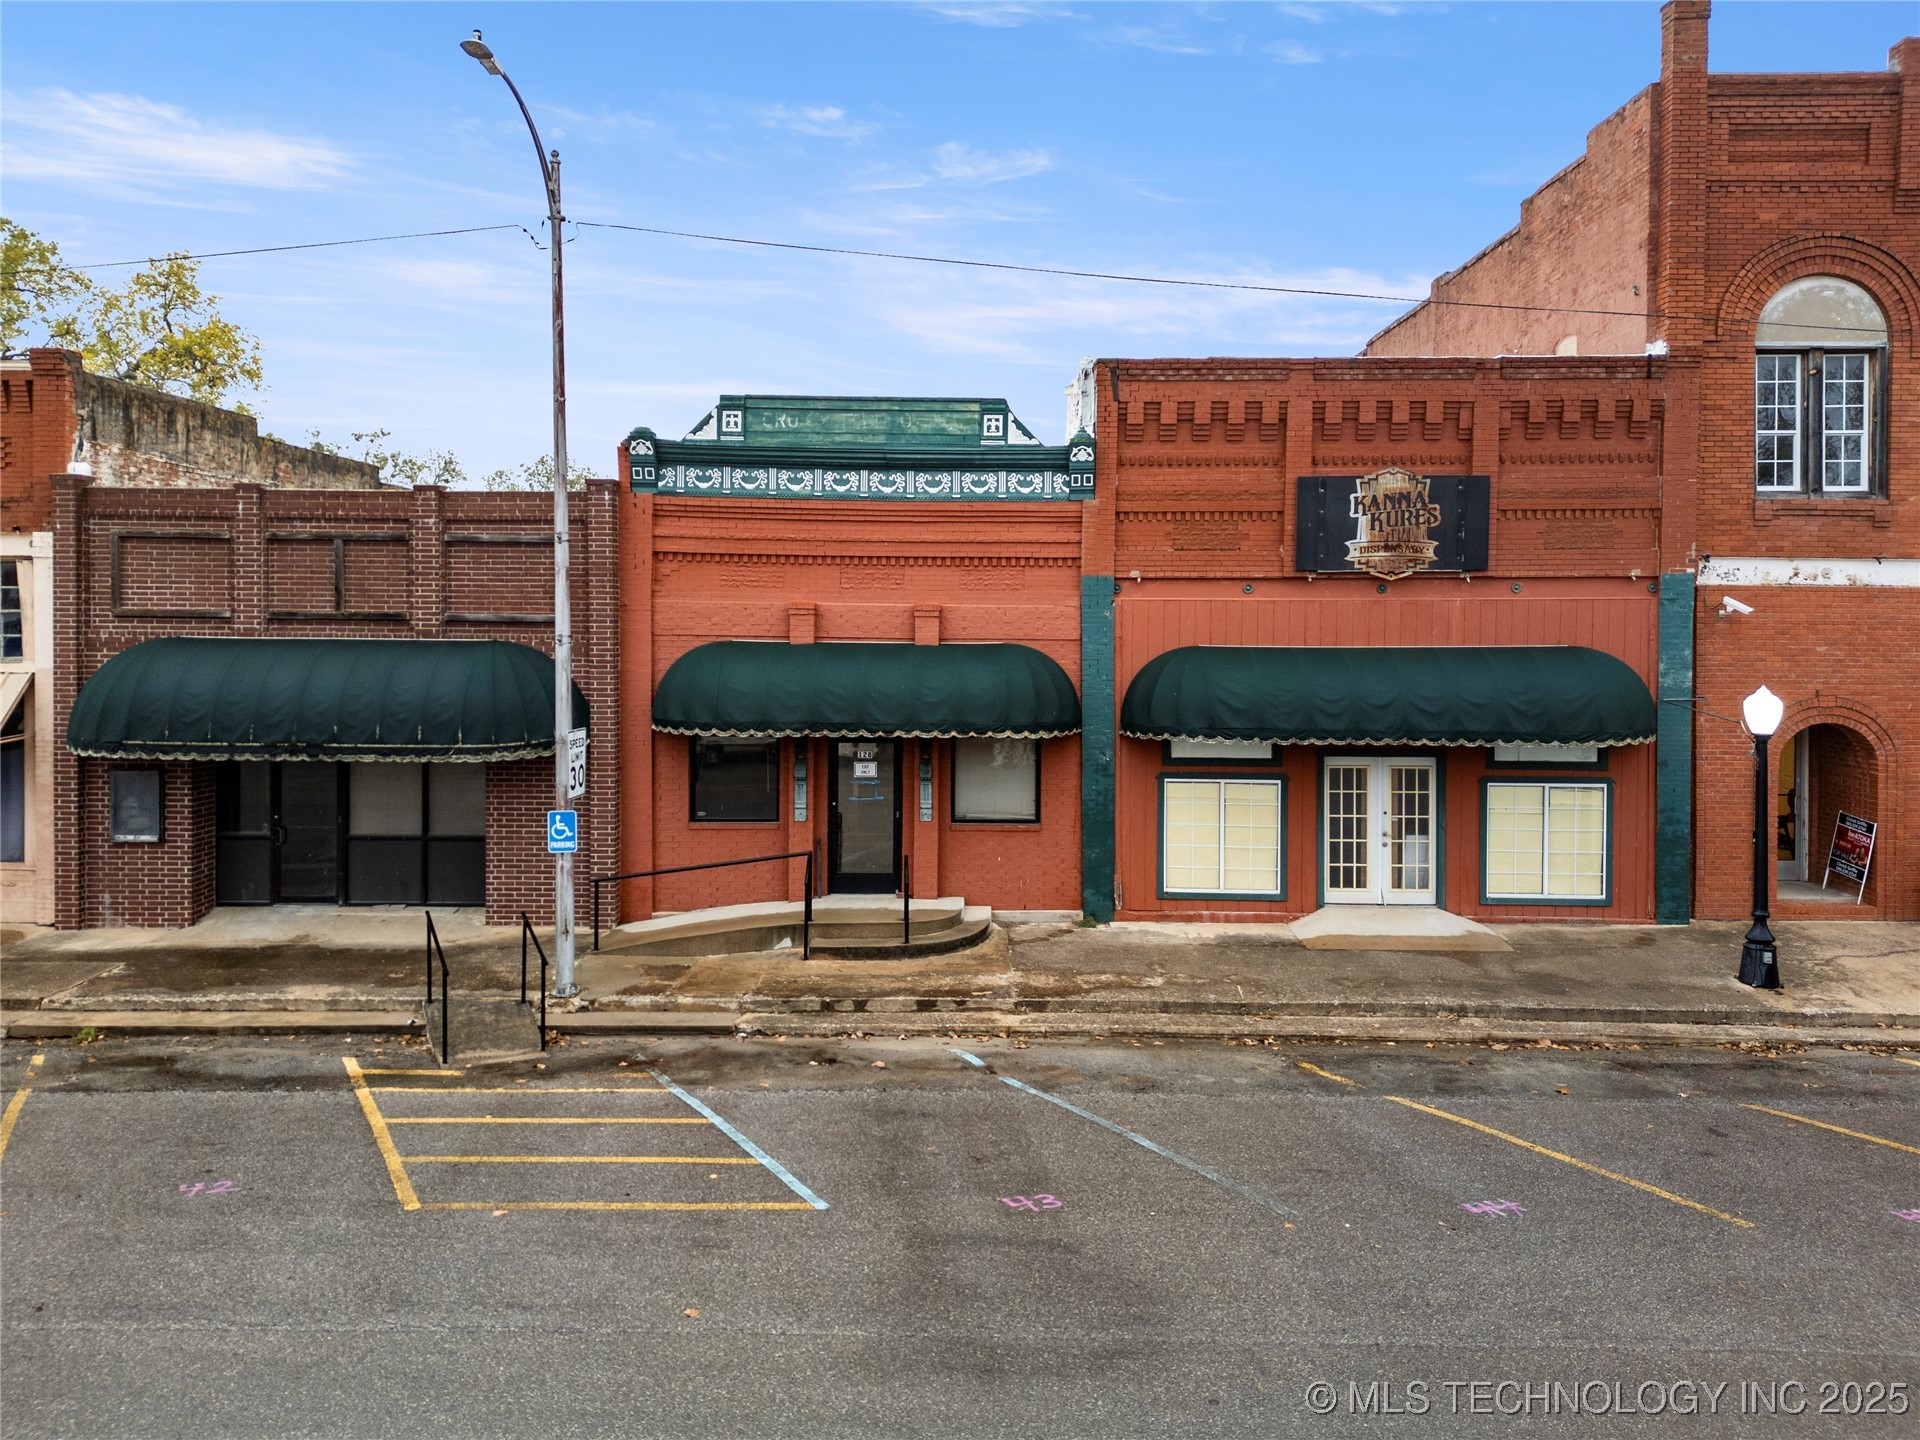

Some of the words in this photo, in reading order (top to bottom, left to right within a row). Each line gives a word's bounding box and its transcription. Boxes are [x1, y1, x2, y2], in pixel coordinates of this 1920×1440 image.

[1353, 491, 1427, 516] KANNA
[1369, 507, 1438, 532] KURES
[1360, 544, 1425, 554] DISPENSARY
[569, 737, 585, 750] SPEED
[571, 750, 583, 762] LIMIT
[570, 764, 584, 791] 30
[550, 841, 575, 849] PARKING
[179, 1181, 241, 1197] 42
[1000, 1194, 1062, 1212] 43
